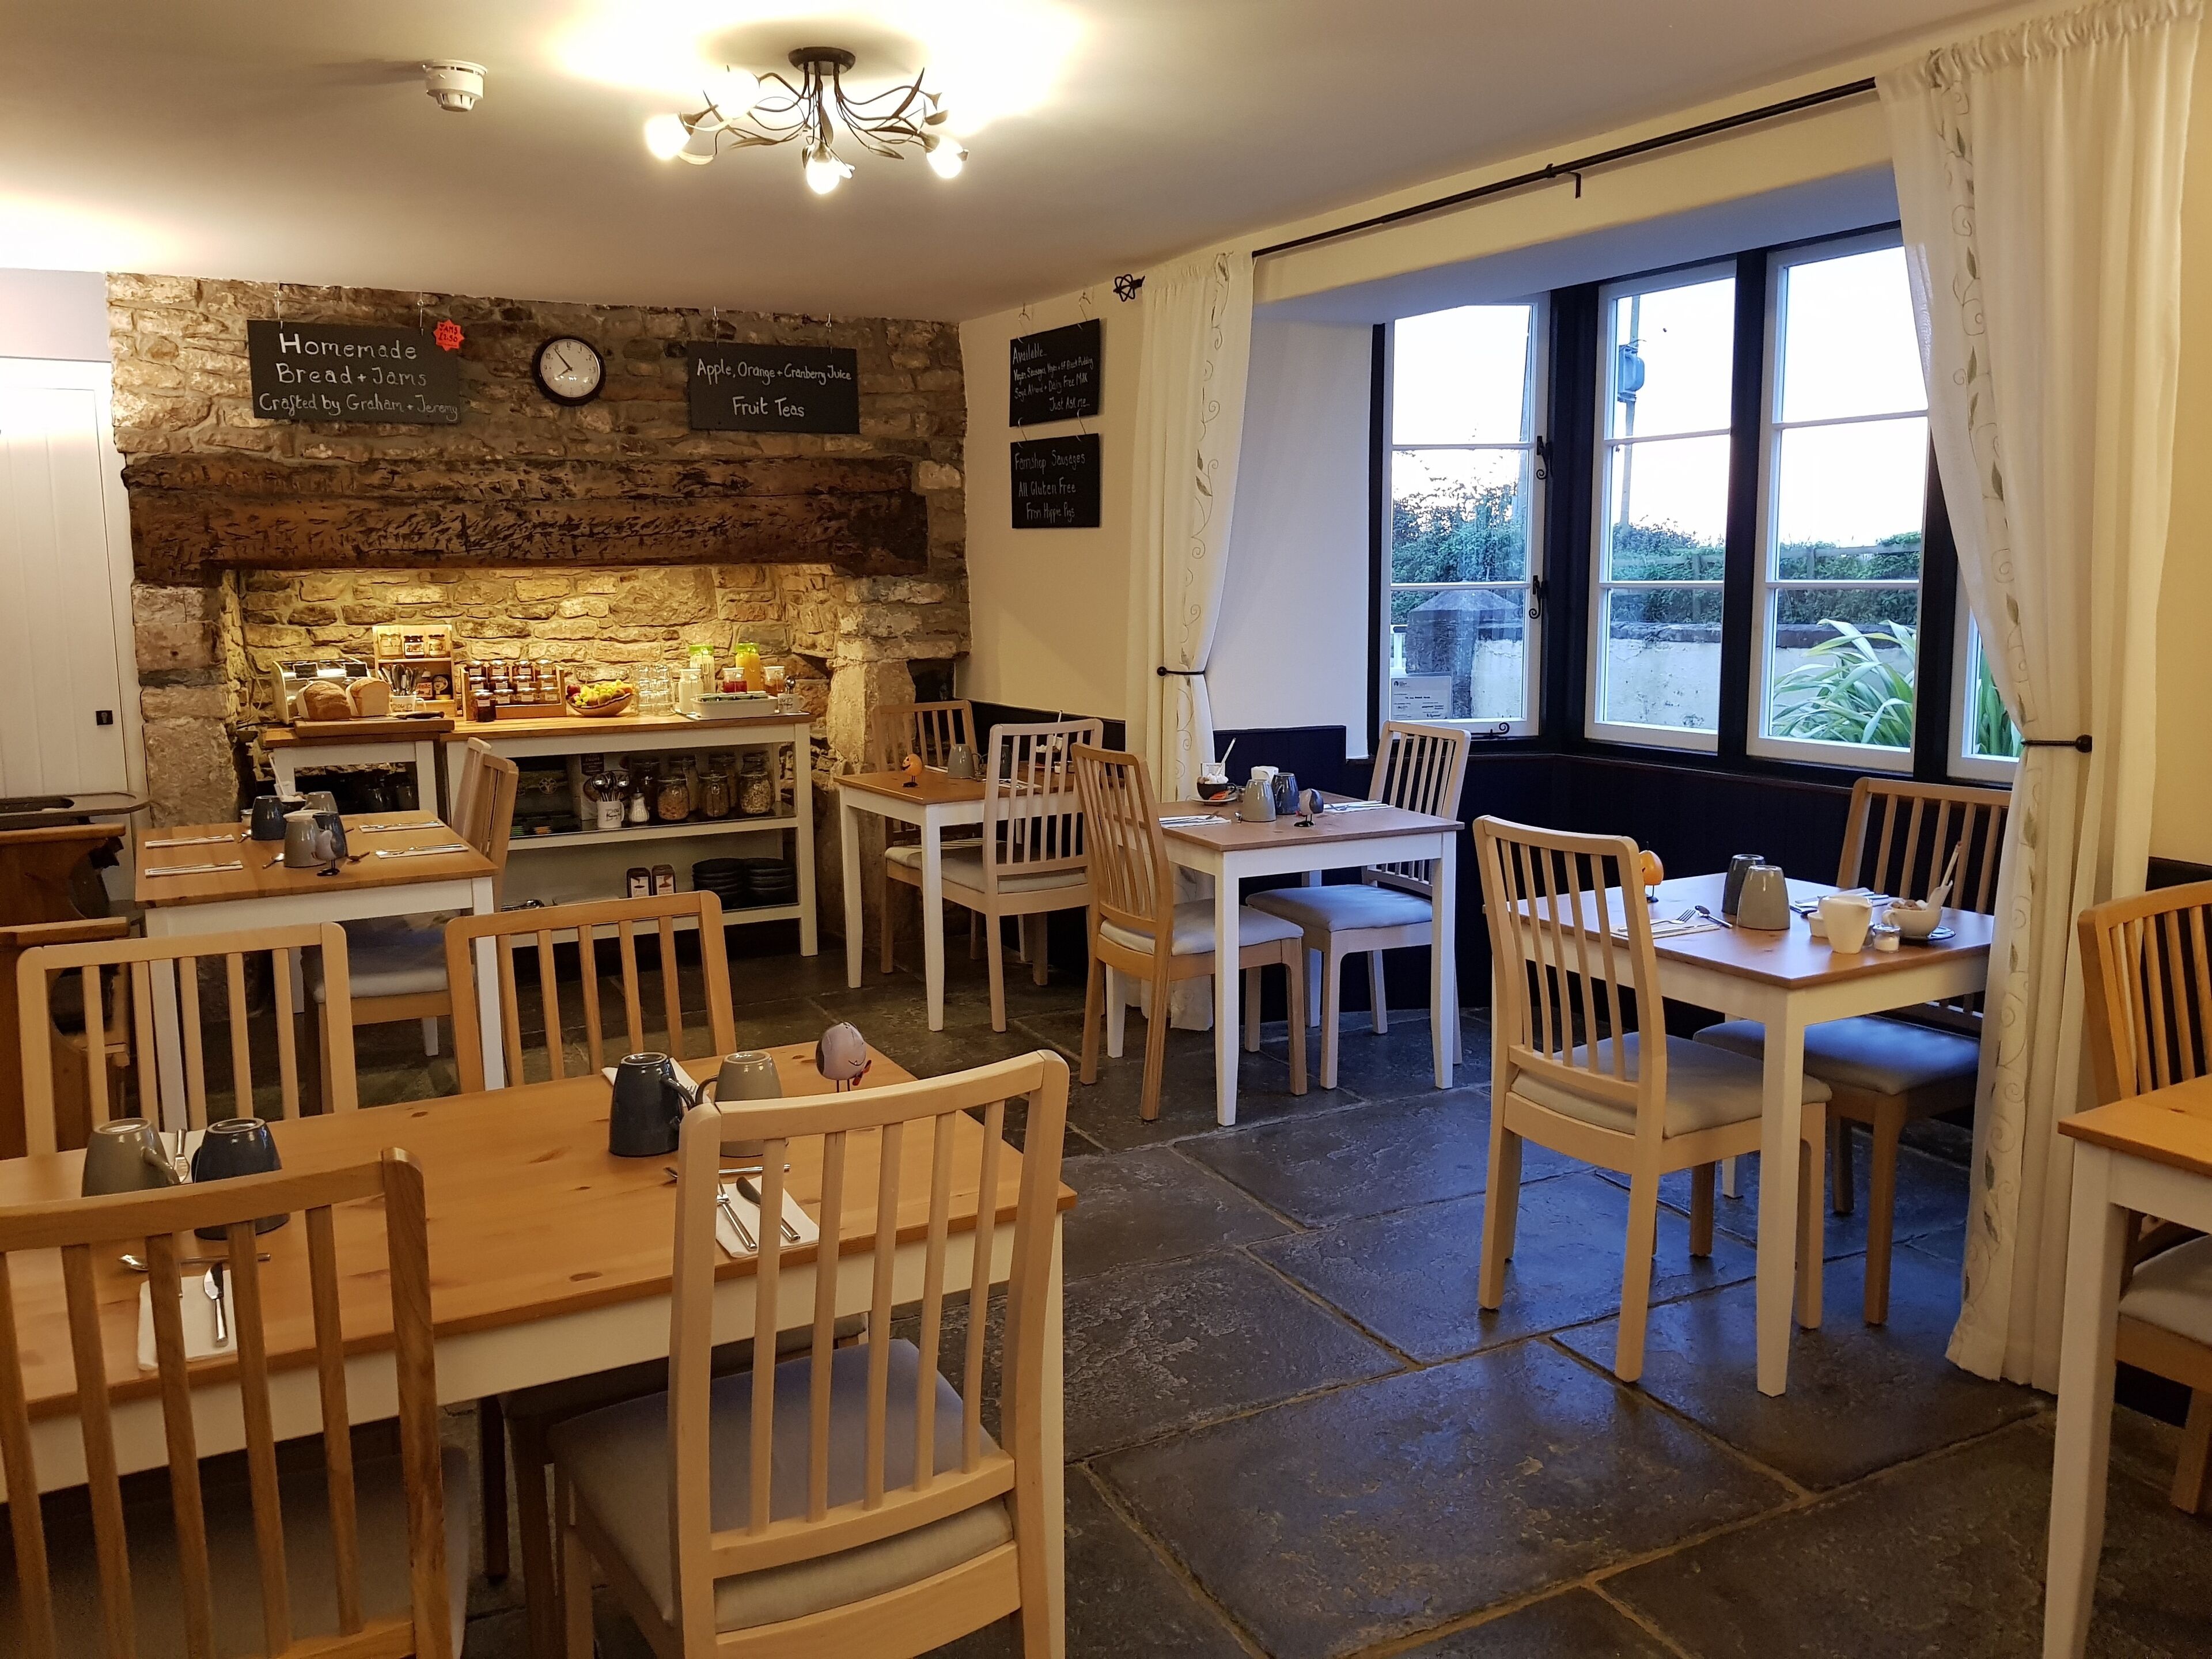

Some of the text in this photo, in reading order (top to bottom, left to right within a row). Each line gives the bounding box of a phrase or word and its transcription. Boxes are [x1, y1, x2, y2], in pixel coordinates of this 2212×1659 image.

[439, 324, 458, 335] JAMS
[279, 332, 417, 360] Homemade
[275, 363, 426, 386] Bread + Jams
[696, 358, 736, 385] Apple,
[737, 361, 776, 386] Orange
[784, 363, 827, 386] Cranberry
[827, 365, 852, 381] Juice
[1063, 375, 1075, 387] Free
[1076, 372, 1088, 385] Milk
[259, 392, 317, 416] Crafted
[321, 394, 341, 416] by
[346, 393, 404, 412] Graham
[414, 394, 458, 422] Jeremy
[732, 396, 805, 417] Fruit Teas
[1049, 396, 1064, 412] Just
[1066, 396, 1076, 410] Ask
[1014, 449, 1086, 475] Farmshop Sausages
[1018, 476, 1077, 498] All Gluten Free
[1026, 501, 1075, 524] From Hippie Pigs
